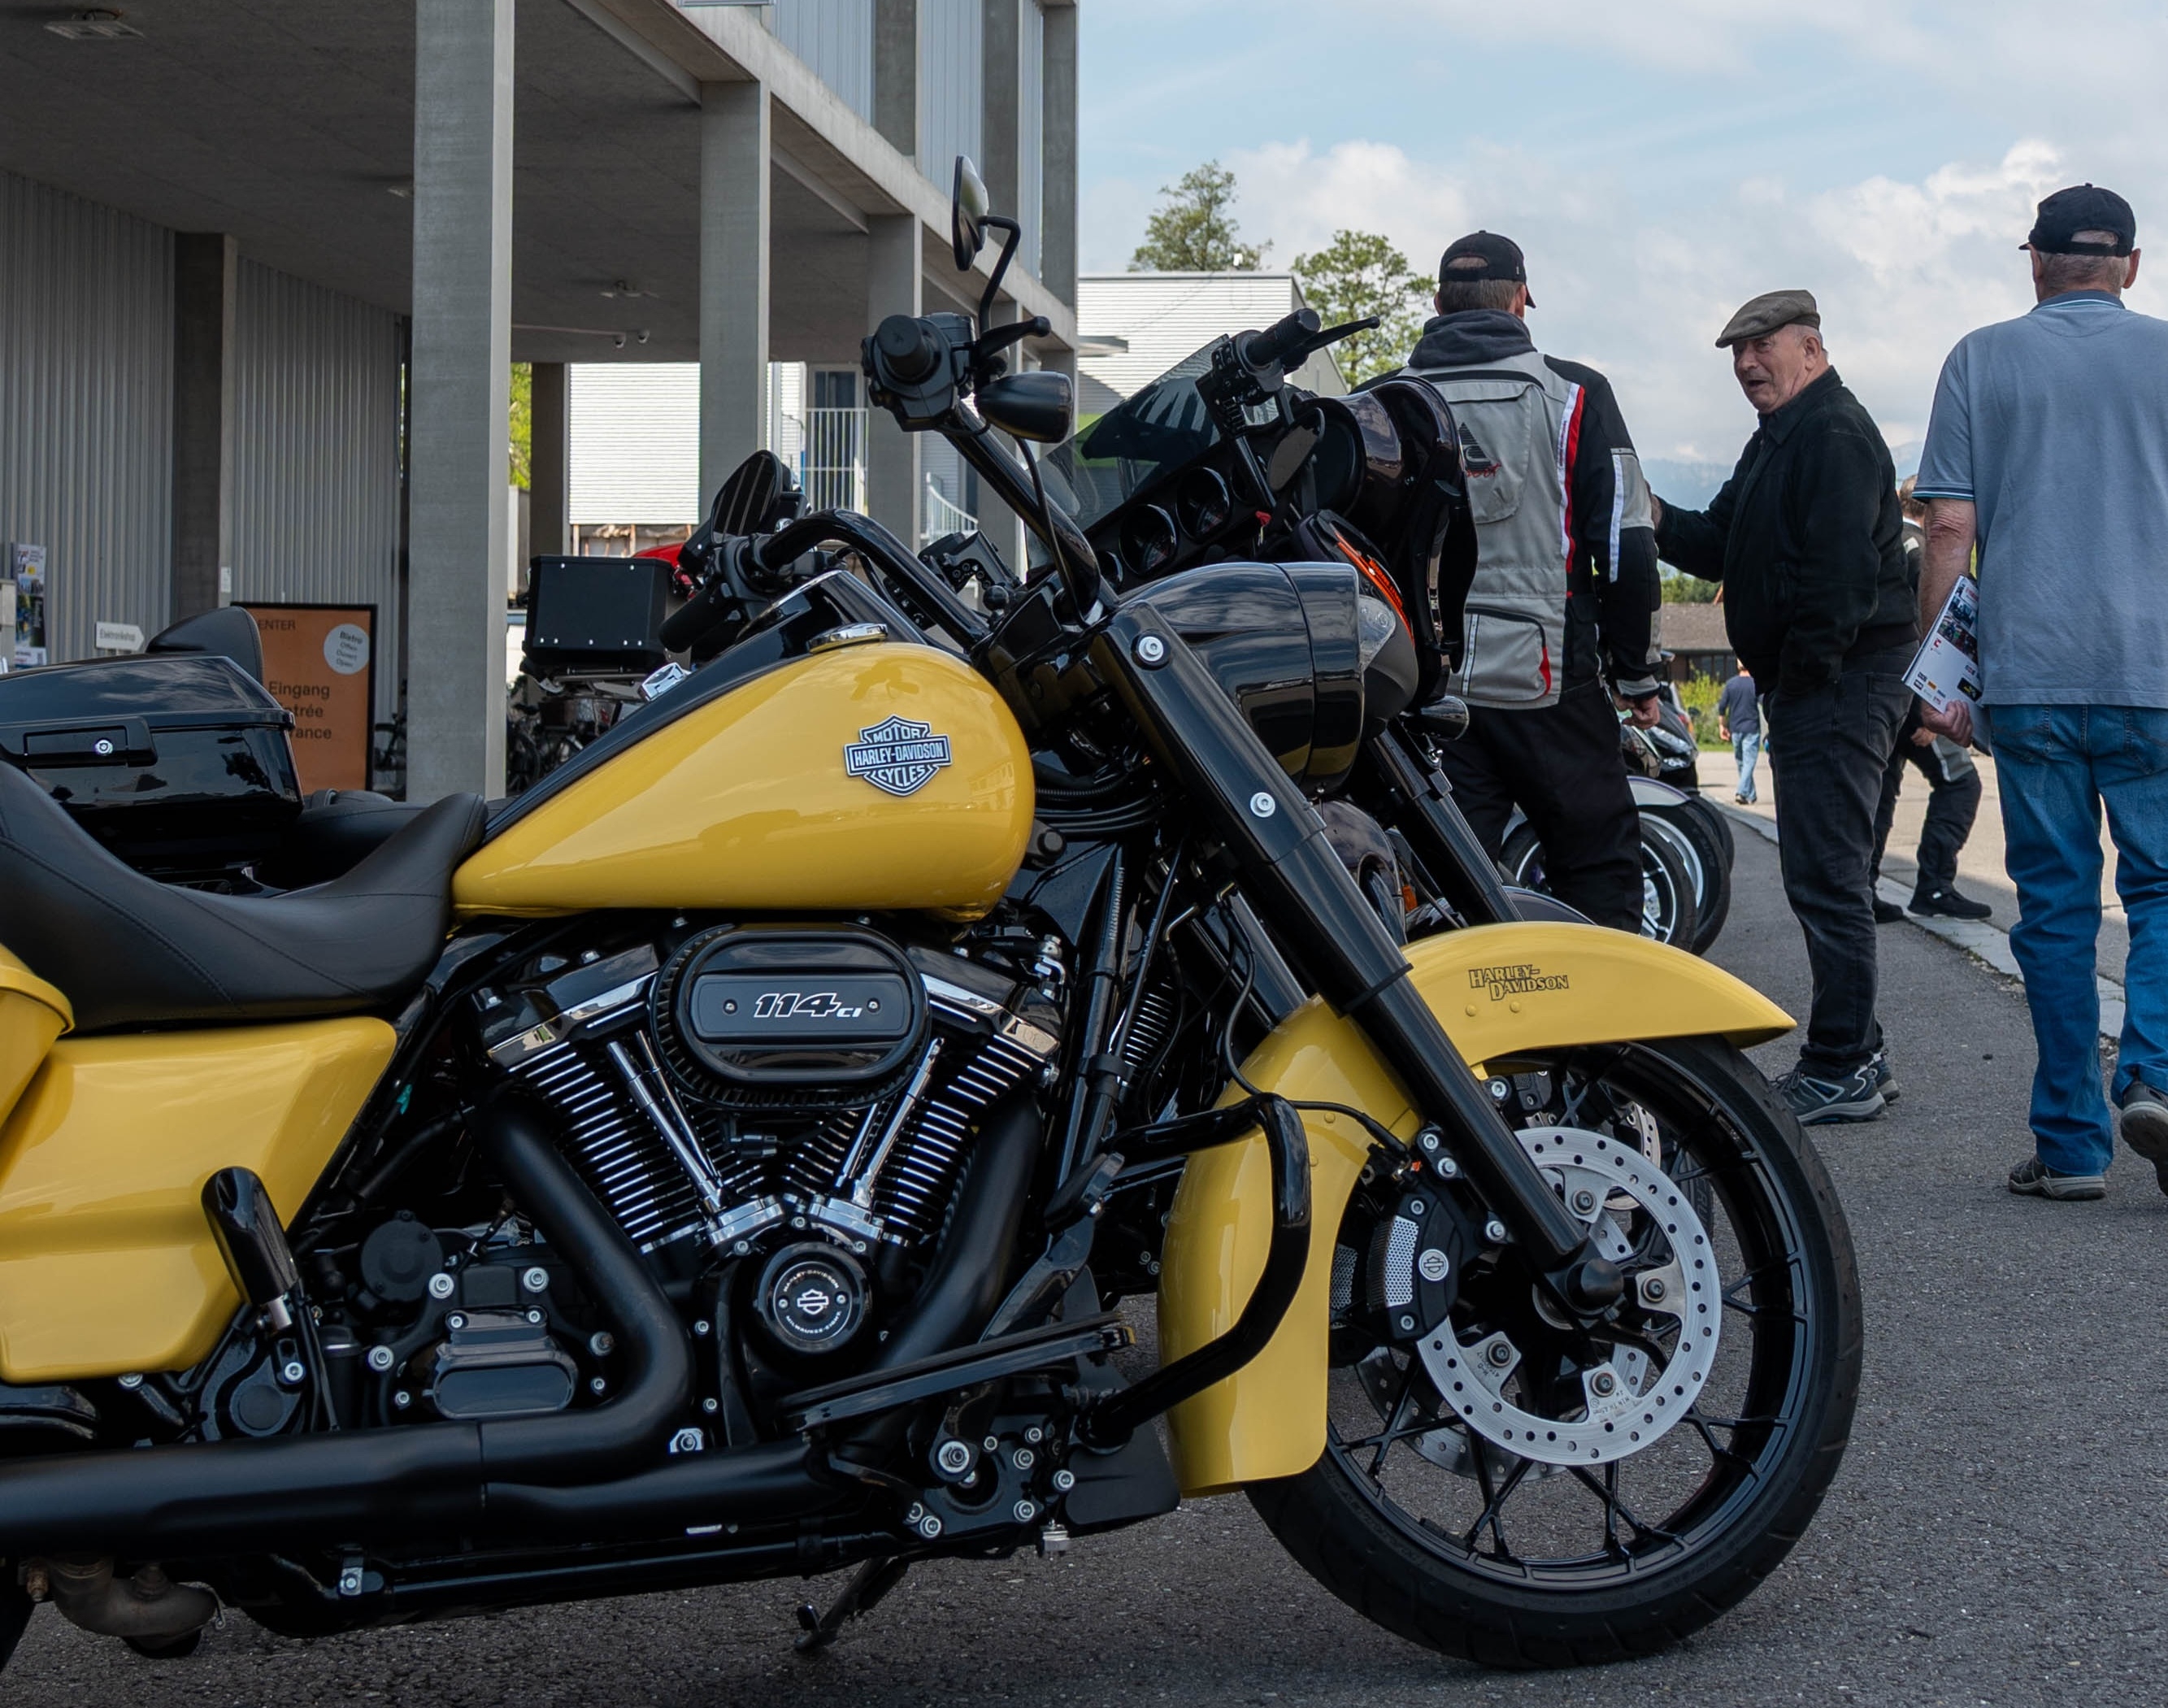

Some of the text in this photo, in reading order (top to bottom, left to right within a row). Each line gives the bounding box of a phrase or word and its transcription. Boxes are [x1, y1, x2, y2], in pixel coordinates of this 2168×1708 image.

[268, 681, 331, 700] Eingang
[872, 724, 922, 743] MOTOR
[854, 741, 945, 767] HARLEY-DAVIDSON
[877, 764, 926, 788] CYCLES
[1468, 964, 1540, 989] HARLEY-
[1489, 975, 1570, 1001] DAVIDSON
